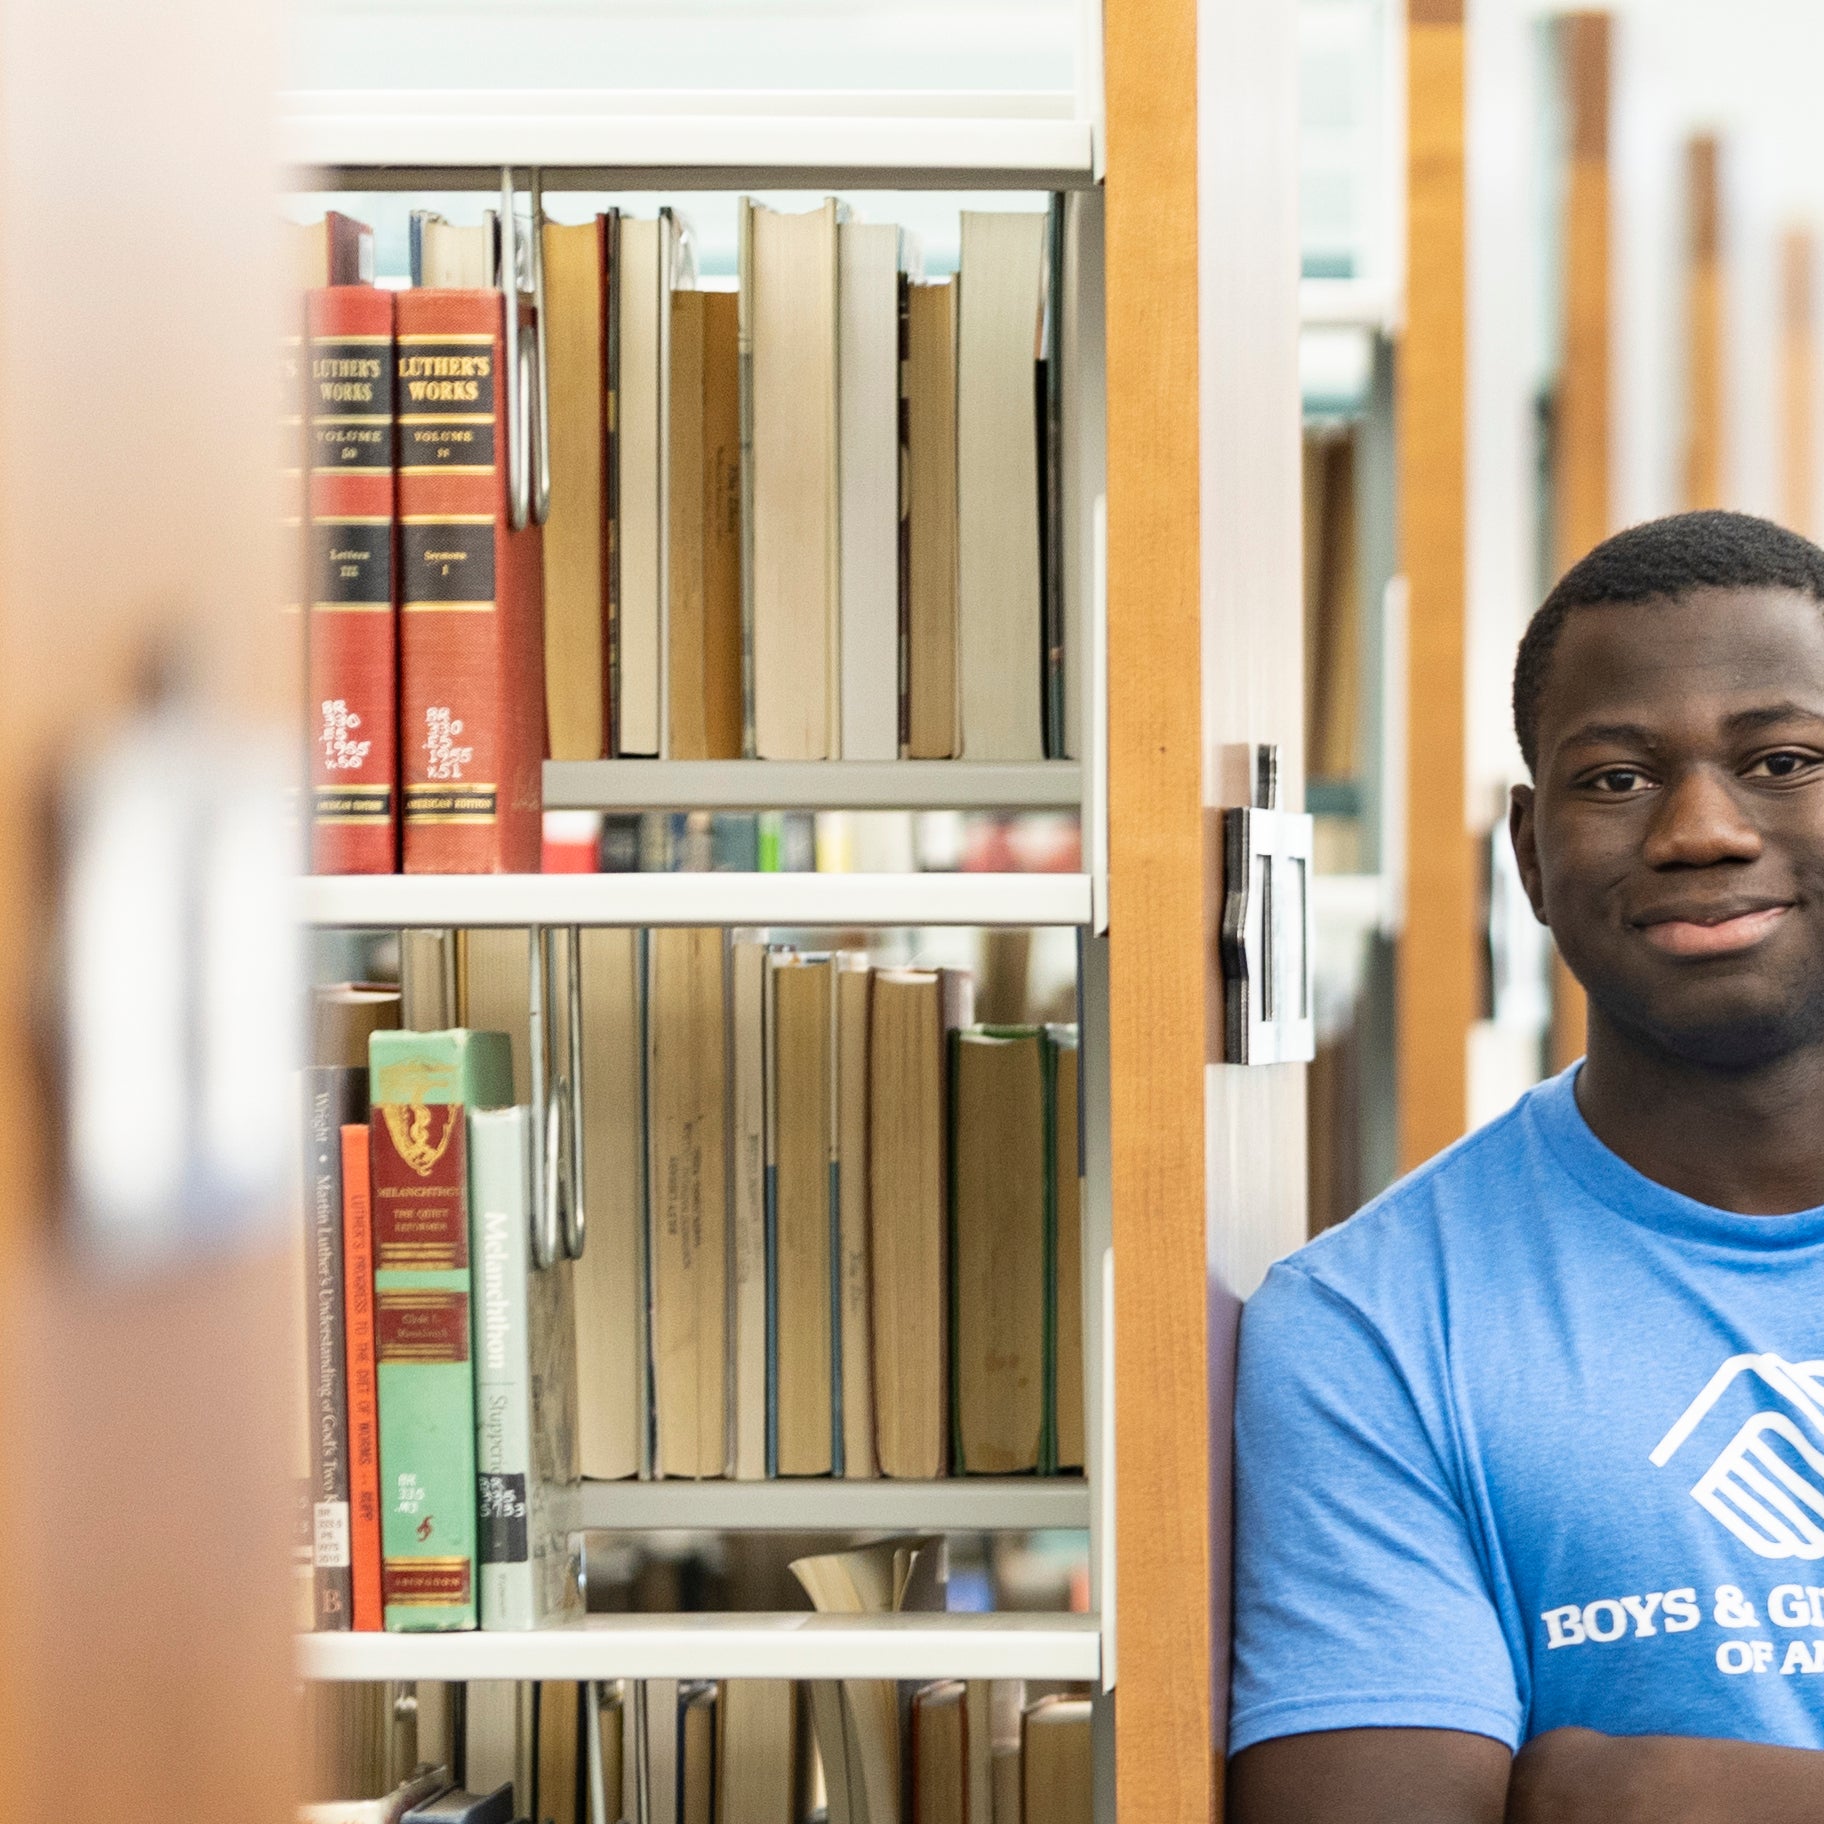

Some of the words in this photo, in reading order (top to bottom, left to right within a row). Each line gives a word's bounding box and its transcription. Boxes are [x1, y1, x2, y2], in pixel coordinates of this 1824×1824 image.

[313, 359, 381, 377] LUTHER'S
[399, 356, 490, 376] LUTHER'S
[320, 382, 372, 401] WORKS
[409, 381, 479, 401] WORKS
[317, 431, 382, 443] VOLUME
[414, 432, 473, 443] VOLUME
[314, 1092, 331, 1142] Wright
[318, 1175, 332, 1222] Martin
[318, 1224, 334, 1284] Luther's
[353, 1256, 368, 1316] PROGRESS
[484, 1211, 510, 1369] Melanchthon
[318, 1285, 337, 1397] Understanding
[355, 1320, 368, 1336] TO
[356, 1370, 370, 1395] DIET
[322, 1400, 333, 1413] of
[357, 1401, 370, 1419] OF
[358, 1422, 371, 1465] WORMS
[323, 1458, 338, 1491] Two
[1541, 1588, 1701, 1650] BOYS
[1713, 1584, 1758, 1628] &
[1716, 1639, 1772, 1676] OF
